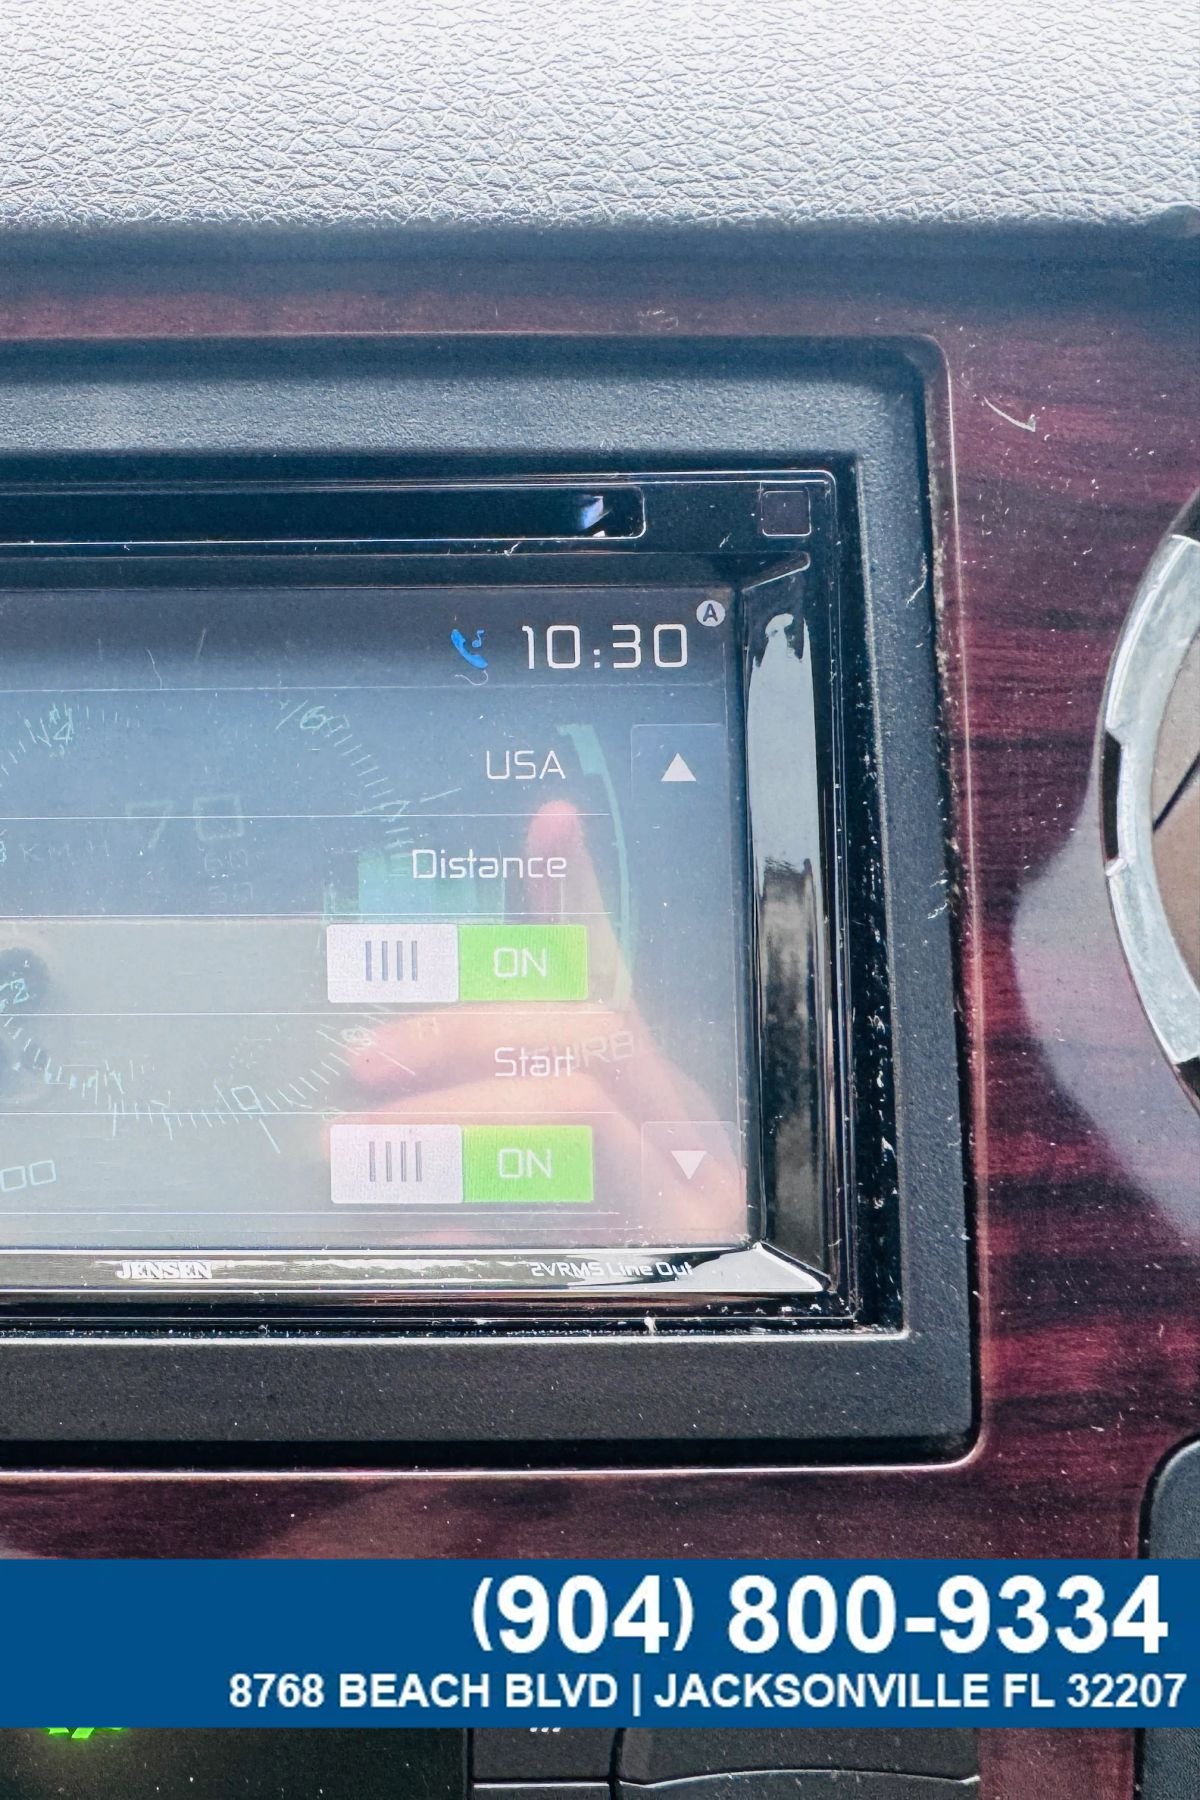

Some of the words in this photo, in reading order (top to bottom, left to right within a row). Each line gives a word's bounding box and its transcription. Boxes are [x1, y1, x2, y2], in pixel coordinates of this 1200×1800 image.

[522, 623, 689, 670] 10:30
[485, 750, 566, 780] USA
[411, 848, 568, 879] Distance
[492, 947, 549, 978] ON
[493, 1047, 576, 1077] Start
[498, 1148, 553, 1180] ON
[114, 1261, 213, 1280] JENSEN
[530, 1261, 604, 1278] 2VRMS
[605, 1261, 654, 1277] Line
[656, 1260, 695, 1277] Out
